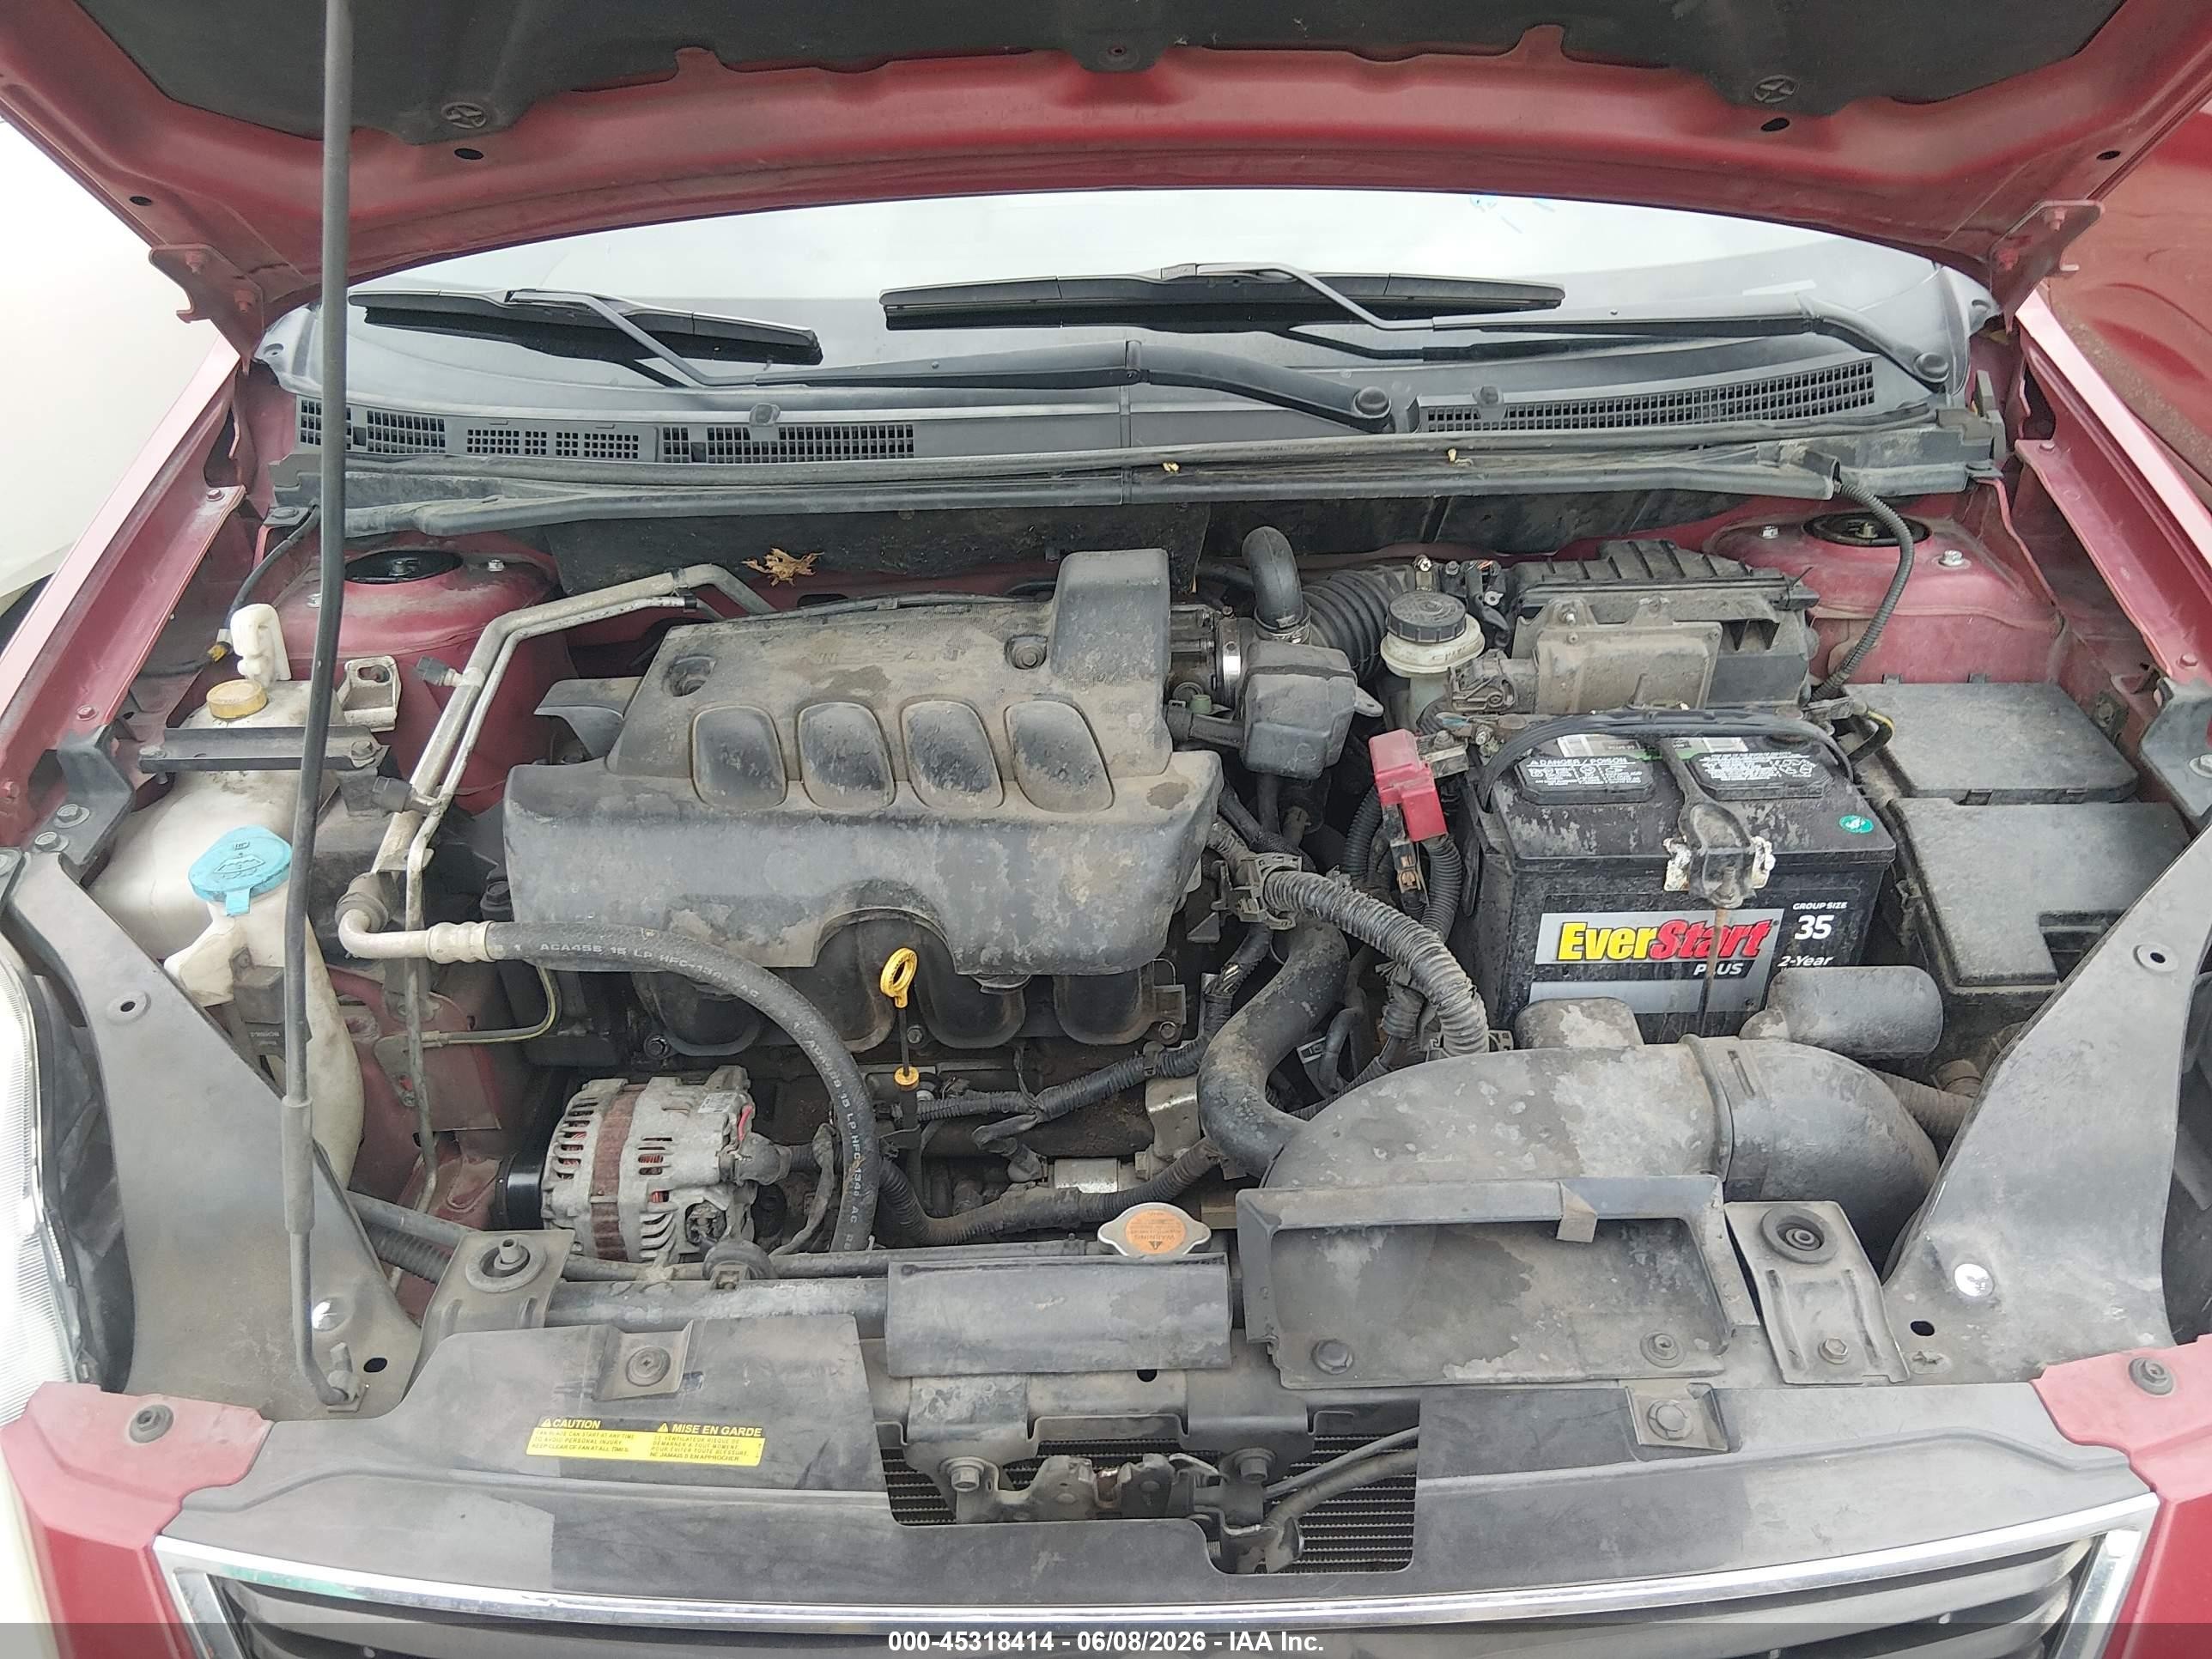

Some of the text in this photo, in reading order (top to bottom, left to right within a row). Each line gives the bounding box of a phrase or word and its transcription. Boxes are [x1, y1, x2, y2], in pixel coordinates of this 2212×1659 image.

[1792, 902, 1826, 910] GROUP
[1794, 915, 1835, 940] 35
[1557, 918, 1773, 961] EverStart
[611, 947, 627, 956] 15
[634, 948, 653, 958] LP
[1777, 955, 1835, 967] 2-Year
[1692, 963, 1744, 976] PUS
[847, 1113, 857, 1131] LP
[849, 1206, 860, 1224] AC
[552, 1419, 601, 1429] CAUTION
[672, 1423, 763, 1437] MISE EN GARDE
